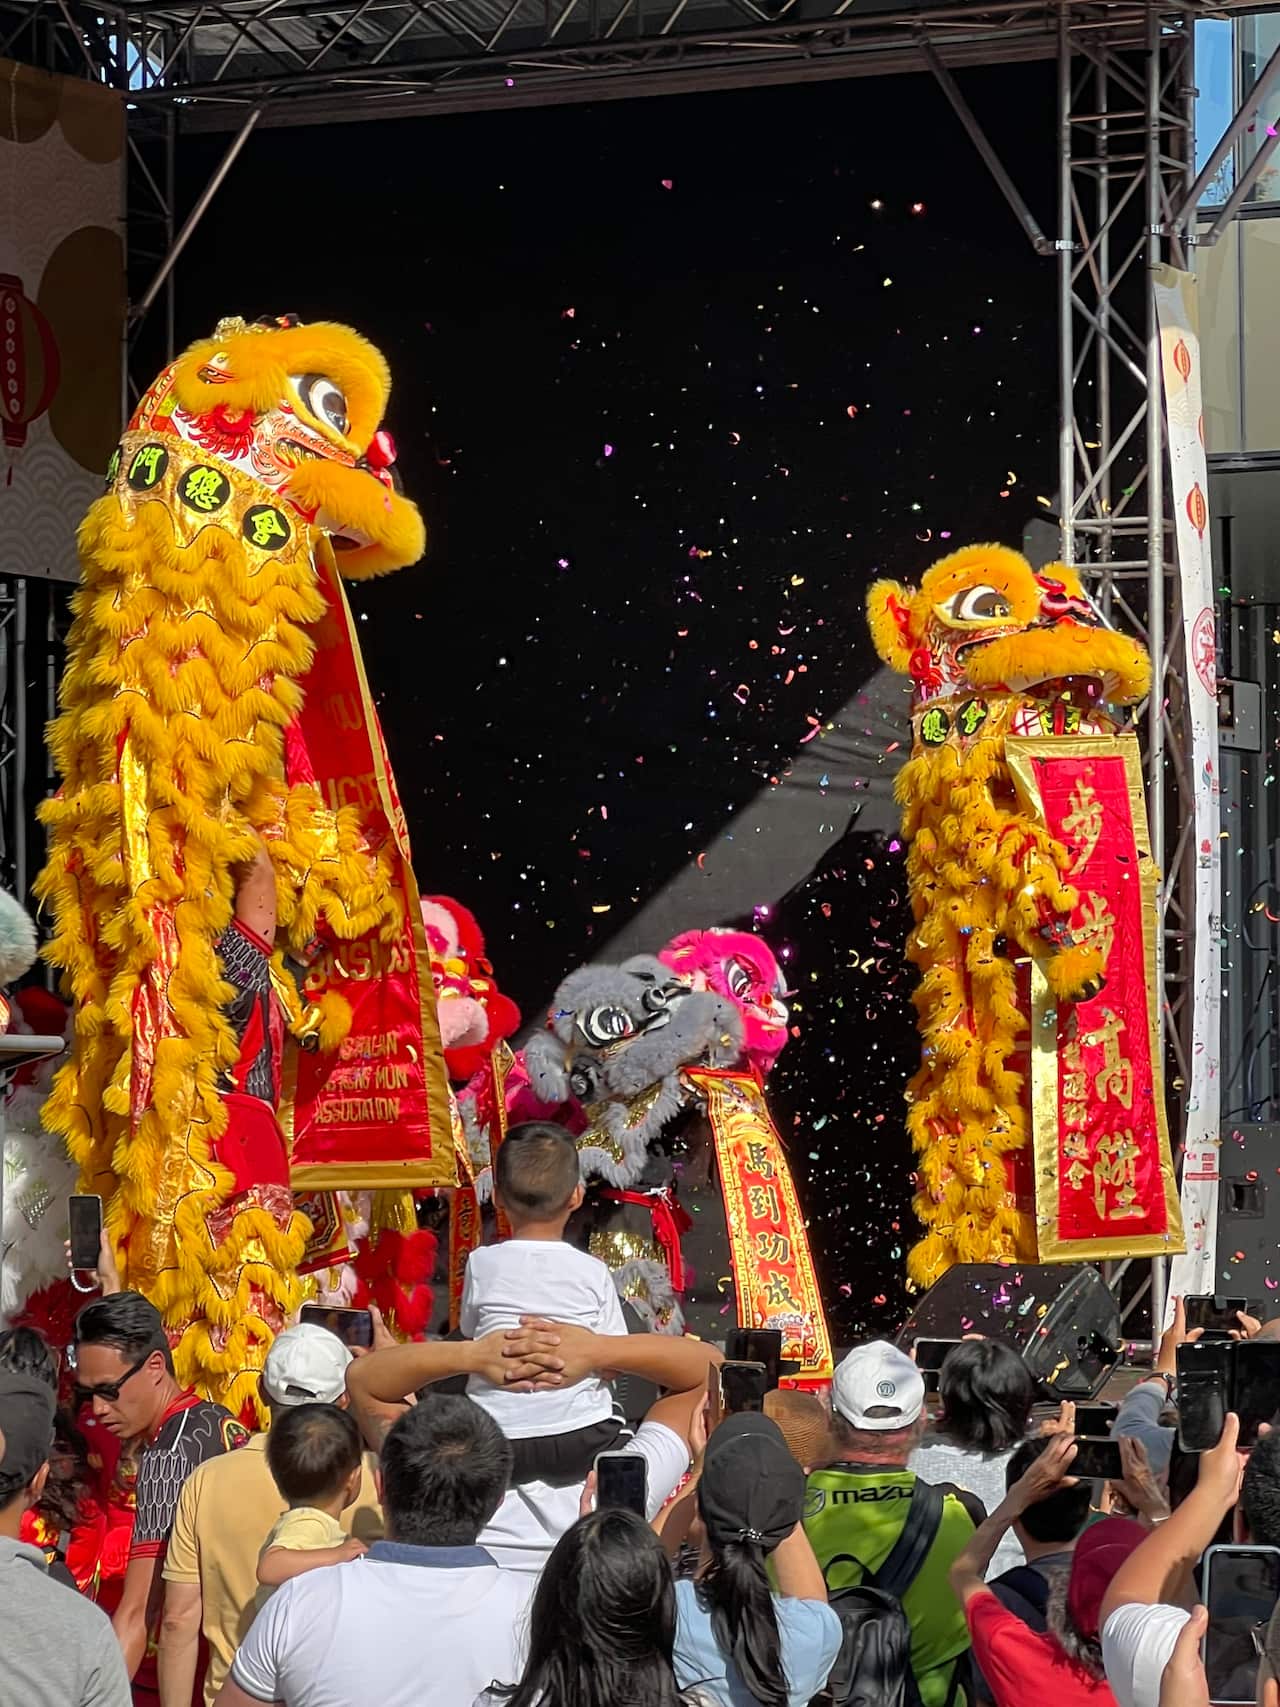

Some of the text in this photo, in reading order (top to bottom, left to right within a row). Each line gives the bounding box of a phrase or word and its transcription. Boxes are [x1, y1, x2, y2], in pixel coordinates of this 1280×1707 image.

[315, 1097, 400, 1124] ASSOCIATION
[746, 1141, 800, 1311] 馬到功成
[832, 1485, 915, 1505] mazd
